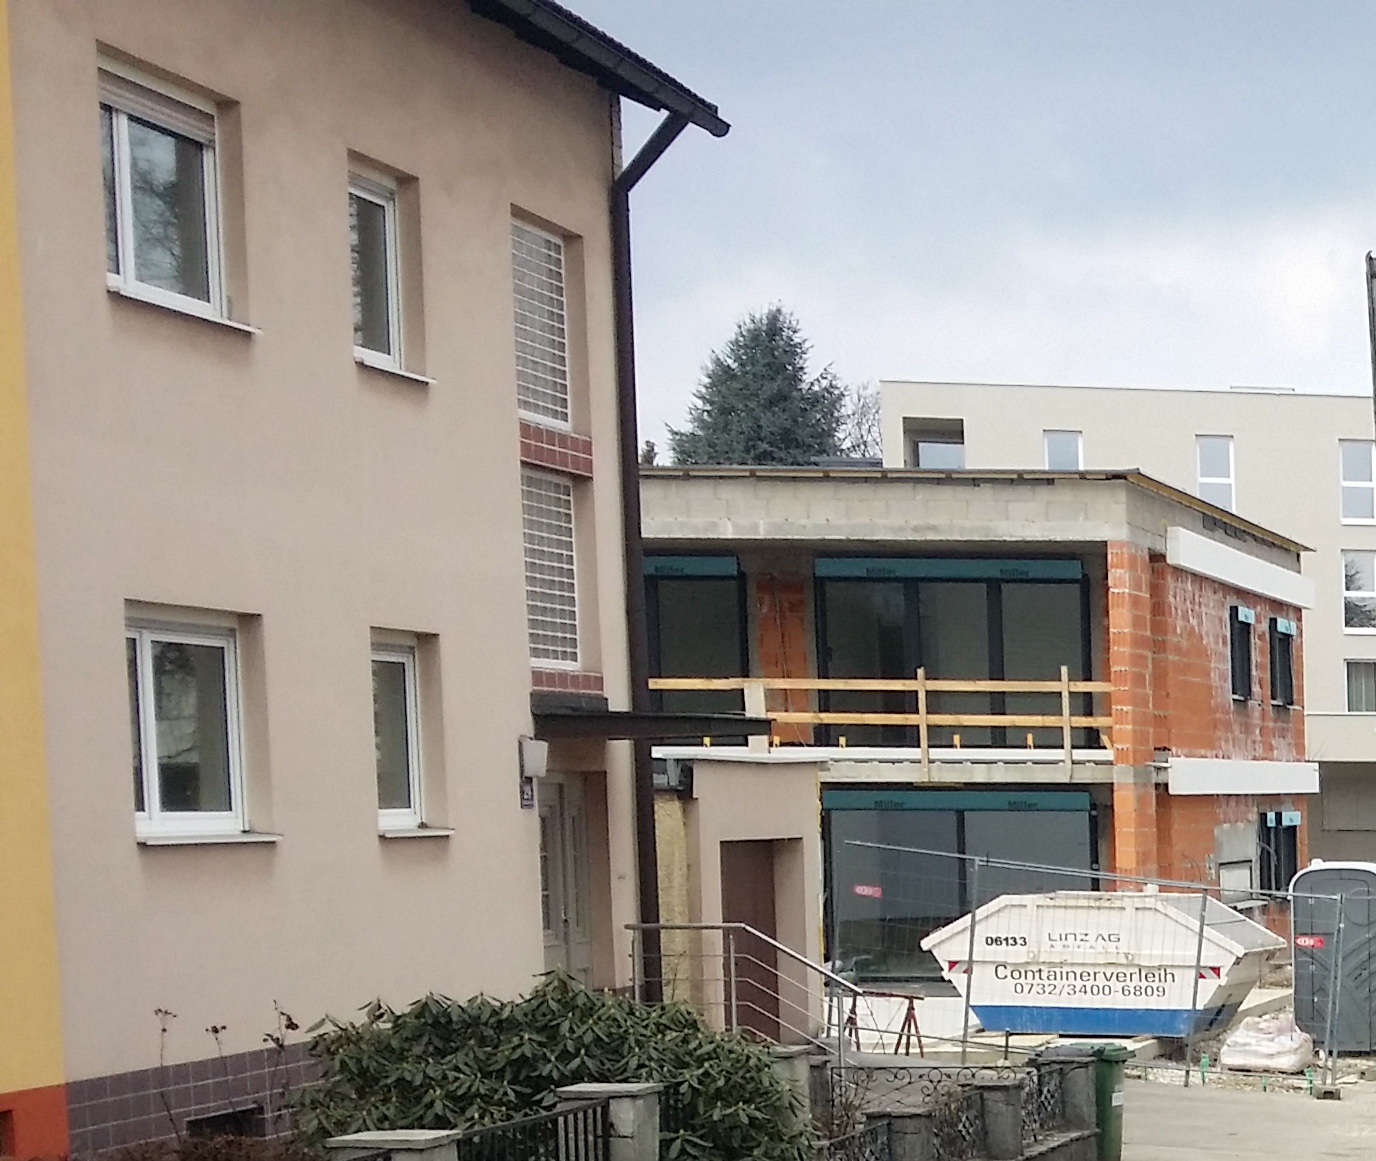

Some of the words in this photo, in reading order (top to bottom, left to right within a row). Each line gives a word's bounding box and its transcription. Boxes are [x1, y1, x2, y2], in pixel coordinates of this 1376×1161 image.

[985, 936, 1027, 947] 06133
[1095, 933, 1121, 943] AG
[994, 964, 1176, 984] Containerverleih
[1014, 983, 1166, 998] 0732/3400-6809
